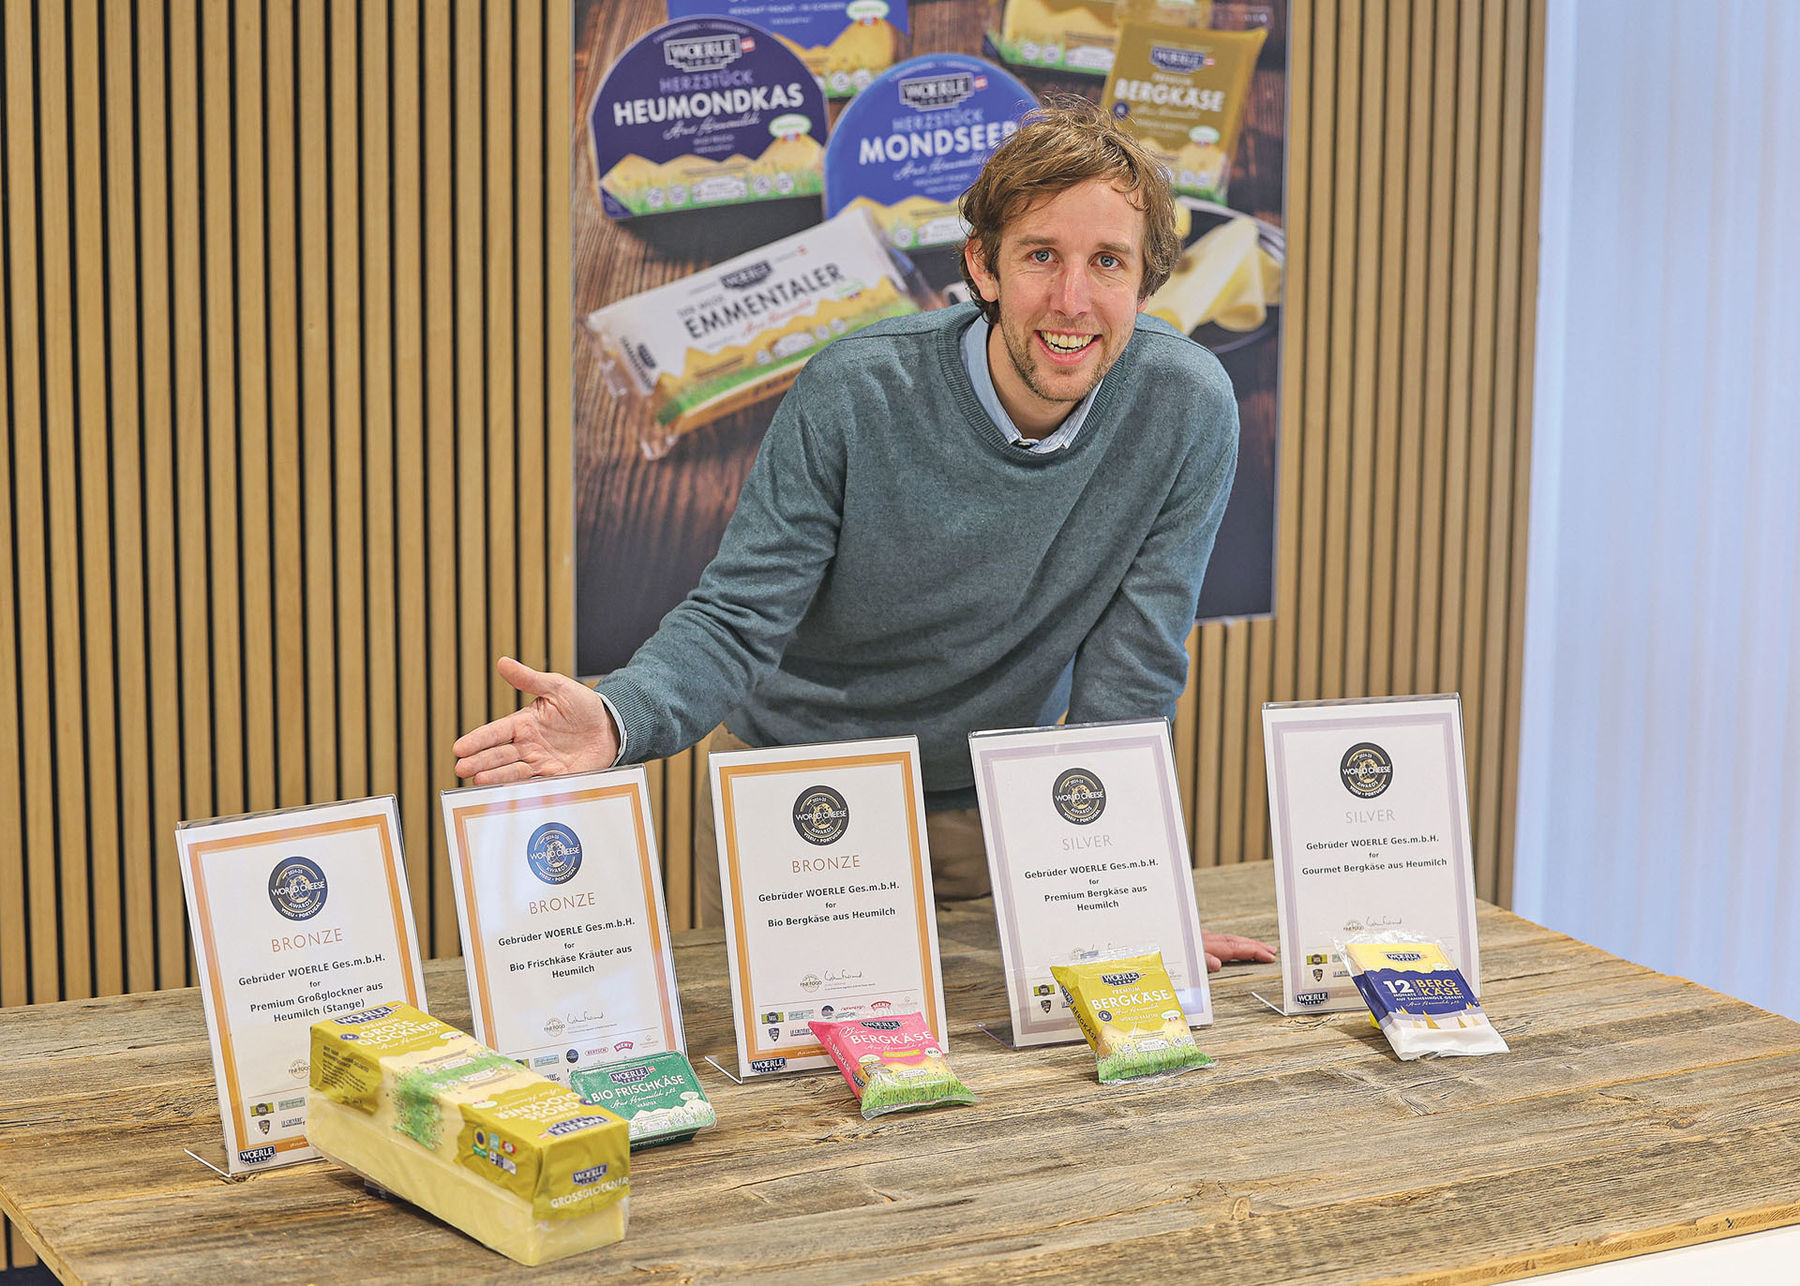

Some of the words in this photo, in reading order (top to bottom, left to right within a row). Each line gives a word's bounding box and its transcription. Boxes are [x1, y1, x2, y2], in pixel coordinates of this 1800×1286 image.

[660, 69, 753, 94] HERZSTÜCK
[1114, 78, 1226, 112] BERGKÄSE
[613, 83, 804, 127] HEUMONDKAS
[892, 108, 984, 132] HERZSTÜCK
[684, 262, 846, 340] EMMENTALER
[1345, 808, 1396, 825] SILVER
[1062, 834, 1113, 851] SILVER
[1306, 840, 1348, 850] Gebrüder
[1350, 837, 1388, 847] WOERLE
[1390, 834, 1440, 845] Ges.m.b.H.
[791, 854, 861, 873] BRONZE
[1024, 868, 1067, 879] Gebrüder
[1069, 863, 1108, 874] WOERLE
[1109, 858, 1158, 871] Ges.m.b.H.
[1302, 866, 1341, 876] Gourmet
[1343, 862, 1385, 874] Bergkäse
[1387, 861, 1404, 869] aus
[1406, 858, 1447, 868] Heumilch
[758, 889, 804, 903] Gebrüder
[806, 885, 846, 898] WOERLE
[848, 881, 900, 894] Ges.m.b.H.
[1044, 891, 1085, 903] Premium
[1087, 885, 1129, 899] Bergkäse
[1131, 885, 1148, 893] aus
[528, 892, 596, 915] BRONZE
[825, 901, 837, 909] for
[1077, 899, 1119, 912] Heumilch
[768, 918, 784, 928] Bio
[785, 912, 830, 928] Bergkäse
[832, 912, 850, 922] aus
[852, 907, 896, 920] Heumilch
[271, 928, 344, 953] BRONZE
[498, 932, 542, 947] Gebrüder
[544, 925, 583, 939] WOERLE
[585, 917, 635, 933] Ges.m.b.H.
[564, 941, 575, 950] for
[510, 962, 525, 972] Bio
[527, 954, 577, 970] Frischkäse
[579, 948, 614, 962] Kräuter
[616, 945, 632, 955] aus
[238, 970, 286, 986] Gebrüder
[288, 962, 329, 978] WOERLE
[332, 953, 386, 970] Ges.m.b.H.
[552, 964, 595, 979] Heumilch
[1104, 972, 1140, 982] WOERLE
[309, 979, 321, 988] for
[1383, 979, 1415, 993] 12
[1415, 979, 1456, 988] BERG
[1421, 987, 1463, 996] KÄSE
[250, 997, 295, 1013] Premium
[297, 985, 364, 1005] Großglockner
[366, 982, 383, 992] aus
[1091, 989, 1171, 1010] BERGKÄSE
[1298, 992, 1328, 1003] WOERLE
[273, 1006, 321, 1022] Heumilch
[323, 998, 366, 1015] (Stange)
[357, 1021, 444, 1046] GLOCKNER
[850, 1031, 933, 1045] BERGKÄSE
[611, 1068, 646, 1081] WOERLE
[753, 1059, 785, 1071] WOERLE
[591, 1090, 613, 1103] BIO
[615, 1074, 685, 1098] FRISCHKÄSE
[241, 1147, 274, 1160] WOERLE
[550, 1176, 630, 1209] GROSSGLOCKNER
